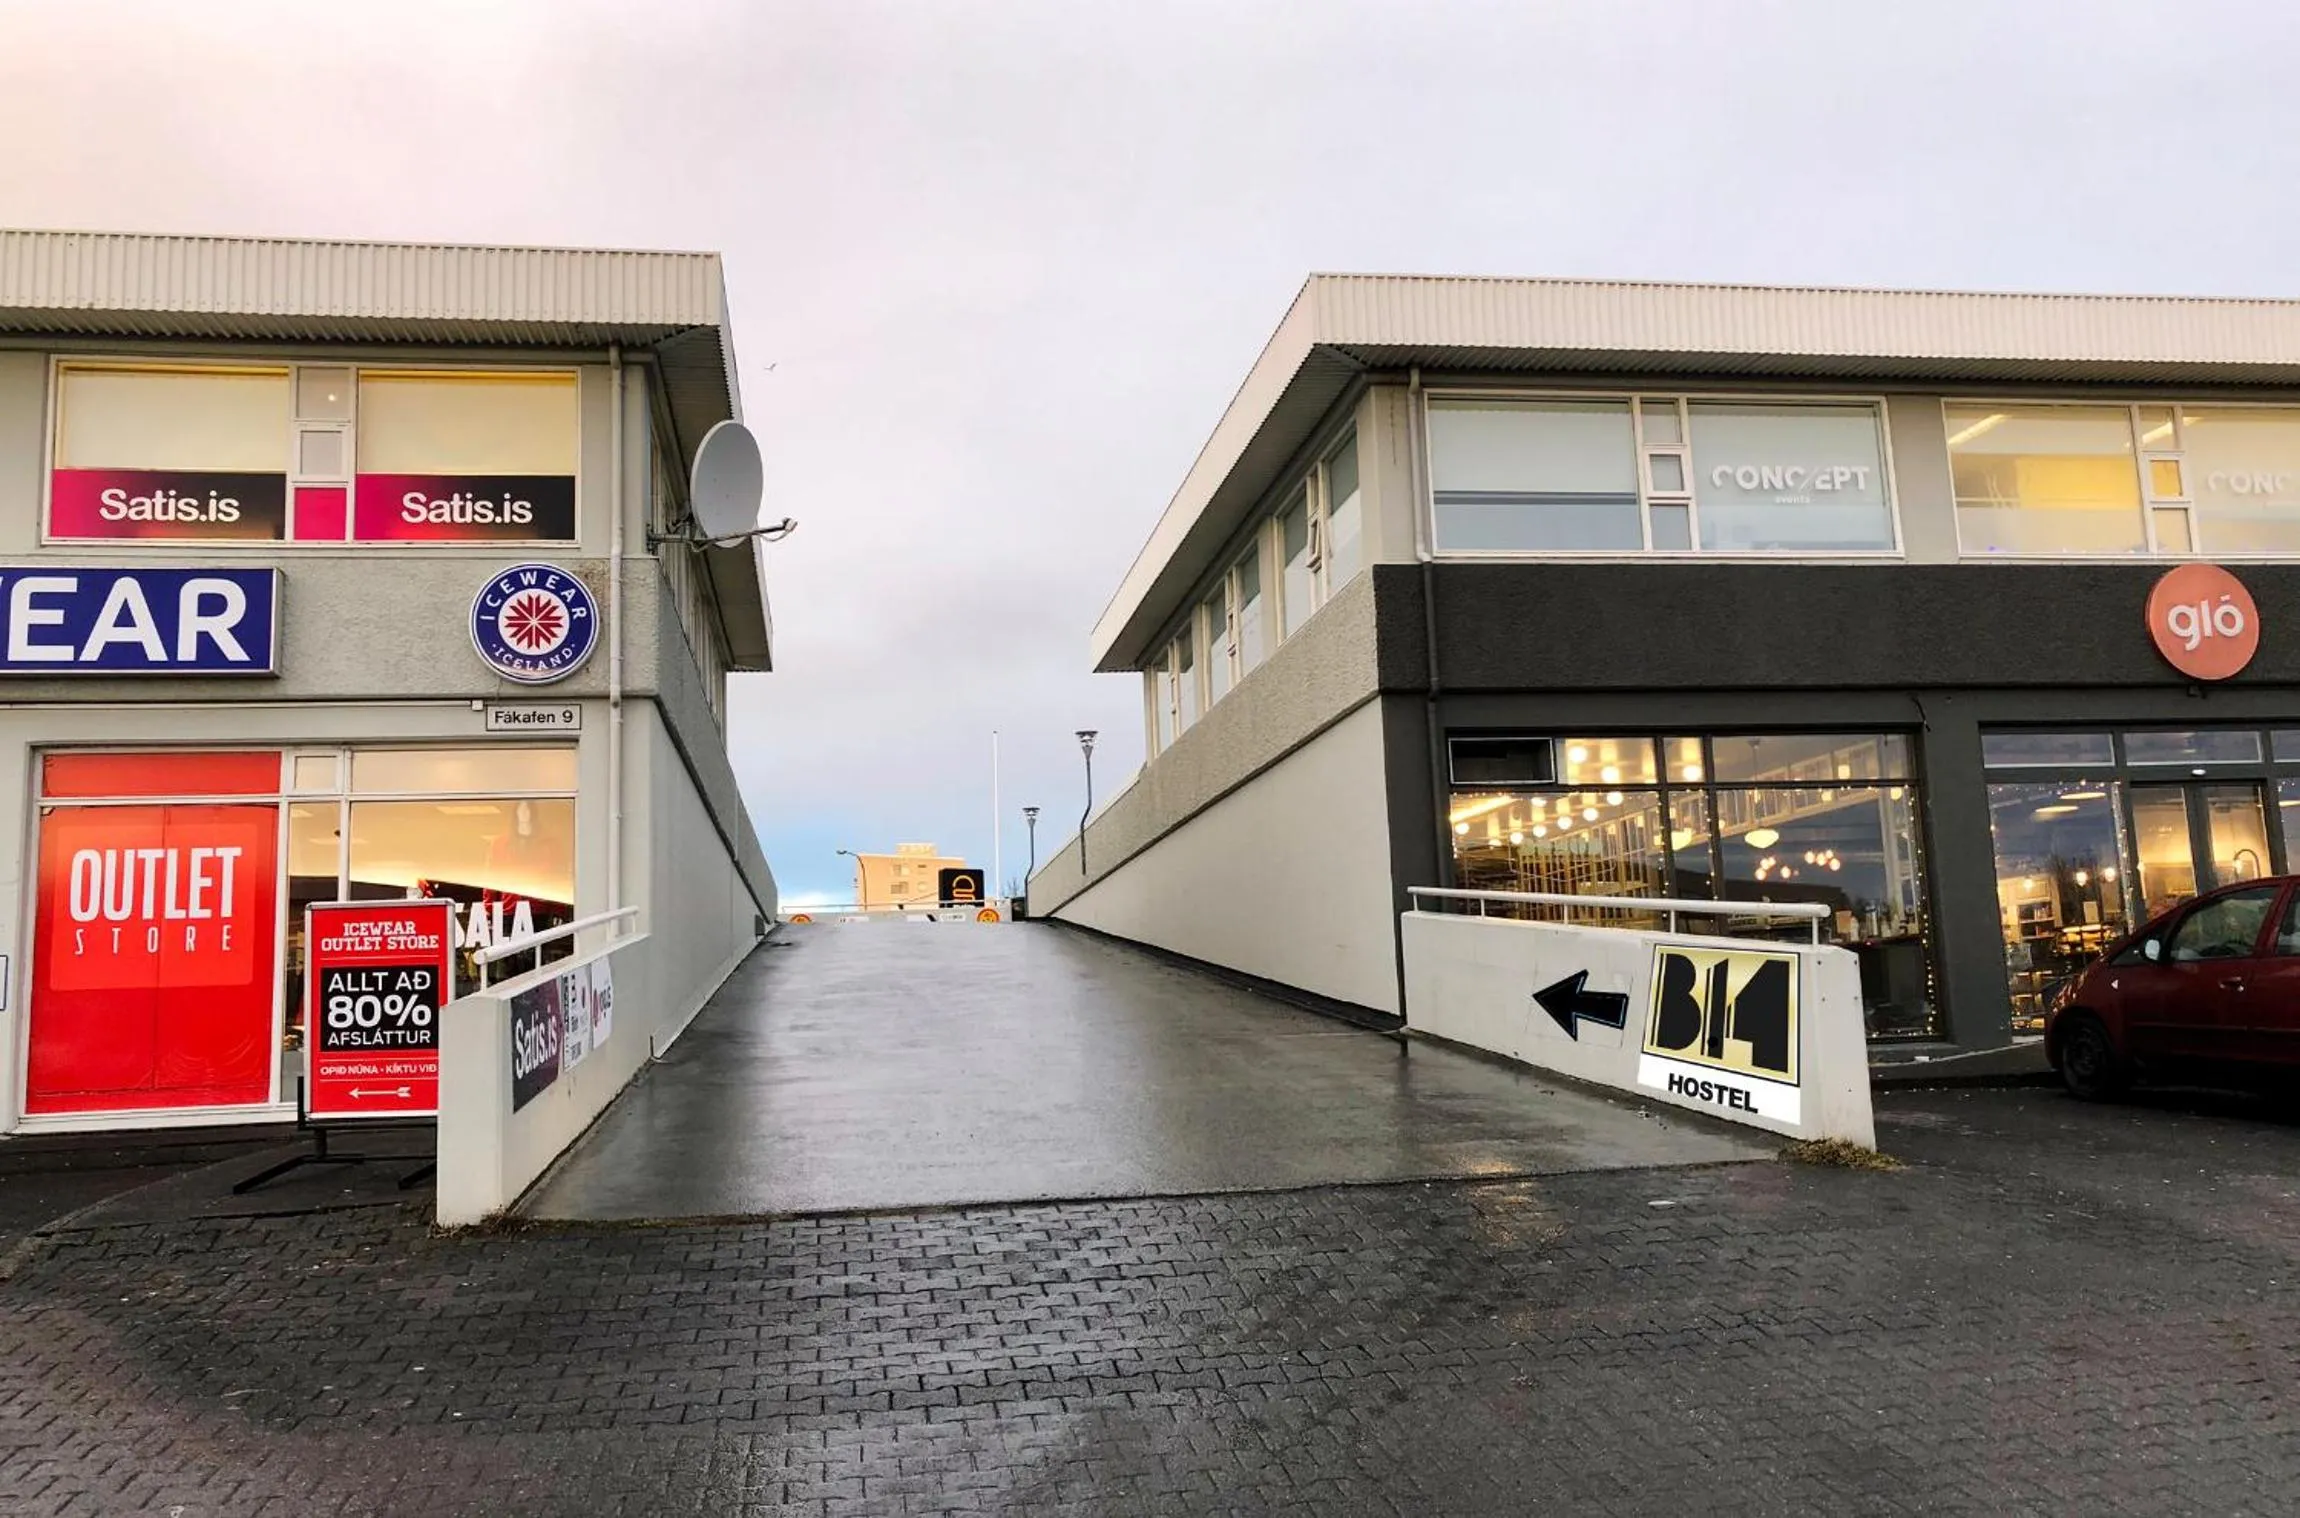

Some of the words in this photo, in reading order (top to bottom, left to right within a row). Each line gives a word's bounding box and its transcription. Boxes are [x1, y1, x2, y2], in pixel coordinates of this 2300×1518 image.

[100, 488, 240, 522] Satis.is
[401, 491, 533, 523] Satis.is
[480, 570, 588, 620] ICEWEAR
[0, 576, 251, 662] EAR
[2167, 594, 2244, 651] gló
[494, 647, 574, 671] ICELAND
[494, 710, 556, 724] Fákafen
[562, 709, 574, 724] 9
[69, 847, 243, 922] OUTLET
[74, 924, 232, 956] STORE
[321, 937, 383, 952] OUTLET
[387, 935, 440, 950] STORE
[343, 921, 416, 936] ICEWEAR
[327, 971, 389, 993] ALLT
[395, 970, 431, 991] AÐ
[327, 994, 432, 1029] 80%
[327, 1027, 431, 1046] AFSLÁTTUR
[515, 1004, 558, 1079] Satis.is
[348, 1063, 379, 1075] NÚNA
[386, 1062, 417, 1074] KÍKTU
[1667, 1072, 1759, 1114] HOSTEL
